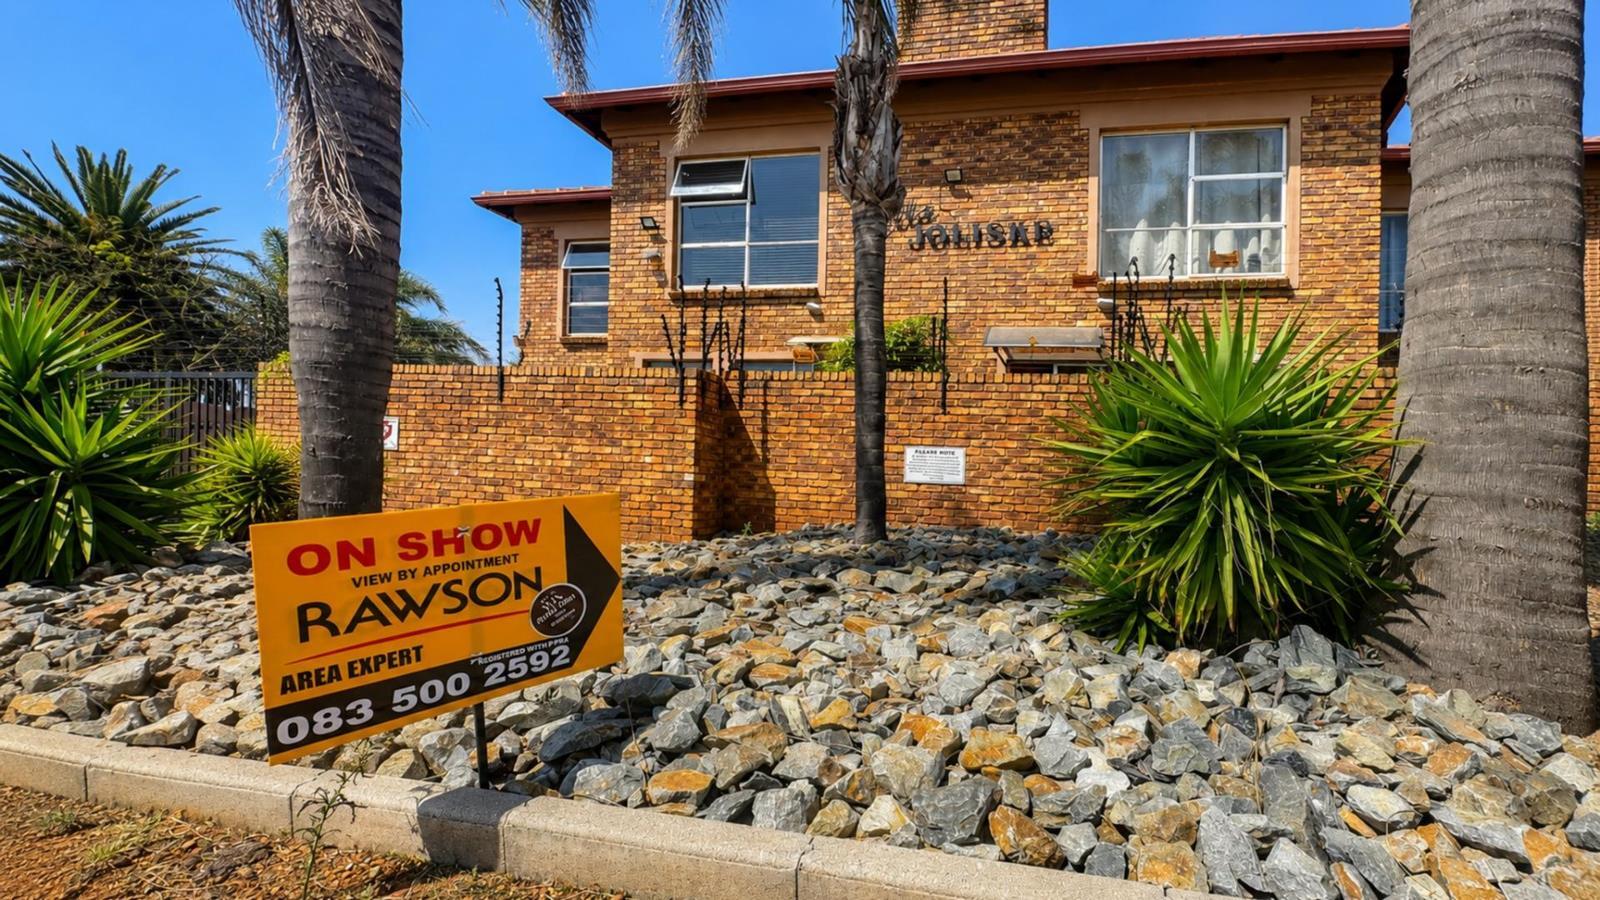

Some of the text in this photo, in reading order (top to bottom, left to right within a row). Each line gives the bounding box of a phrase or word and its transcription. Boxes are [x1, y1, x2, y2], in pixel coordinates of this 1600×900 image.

[286, 518, 542, 576] ON SHOW
[351, 553, 520, 588] VIEW BY APPOINTMENT
[297, 566, 544, 644] RAWSON
[280, 645, 424, 696] AREA EXPERT
[478, 648, 526, 665] REGISTERED
[526, 641, 548, 652] WITH
[276, 645, 571, 746] 083 500 2592
